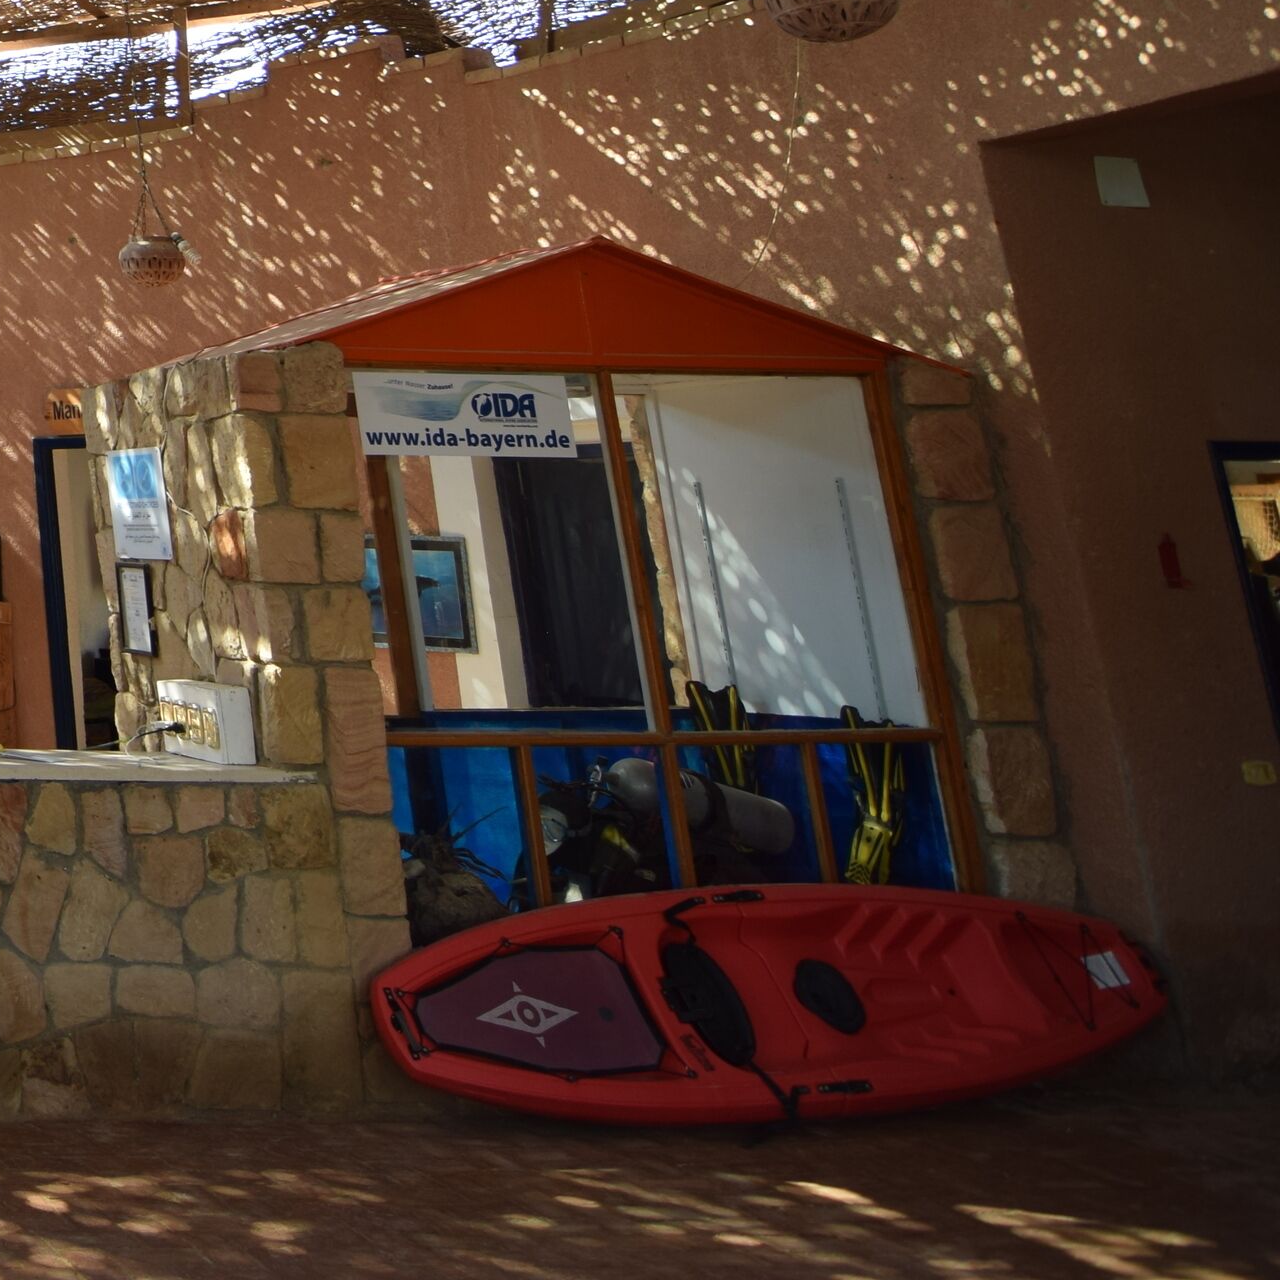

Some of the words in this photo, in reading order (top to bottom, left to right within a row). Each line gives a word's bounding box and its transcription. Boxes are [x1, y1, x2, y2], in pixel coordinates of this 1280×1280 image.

[53, 400, 81, 420] Man
[492, 393, 536, 418] IDA
[366, 427, 571, 451] www.ida-bayern.de
